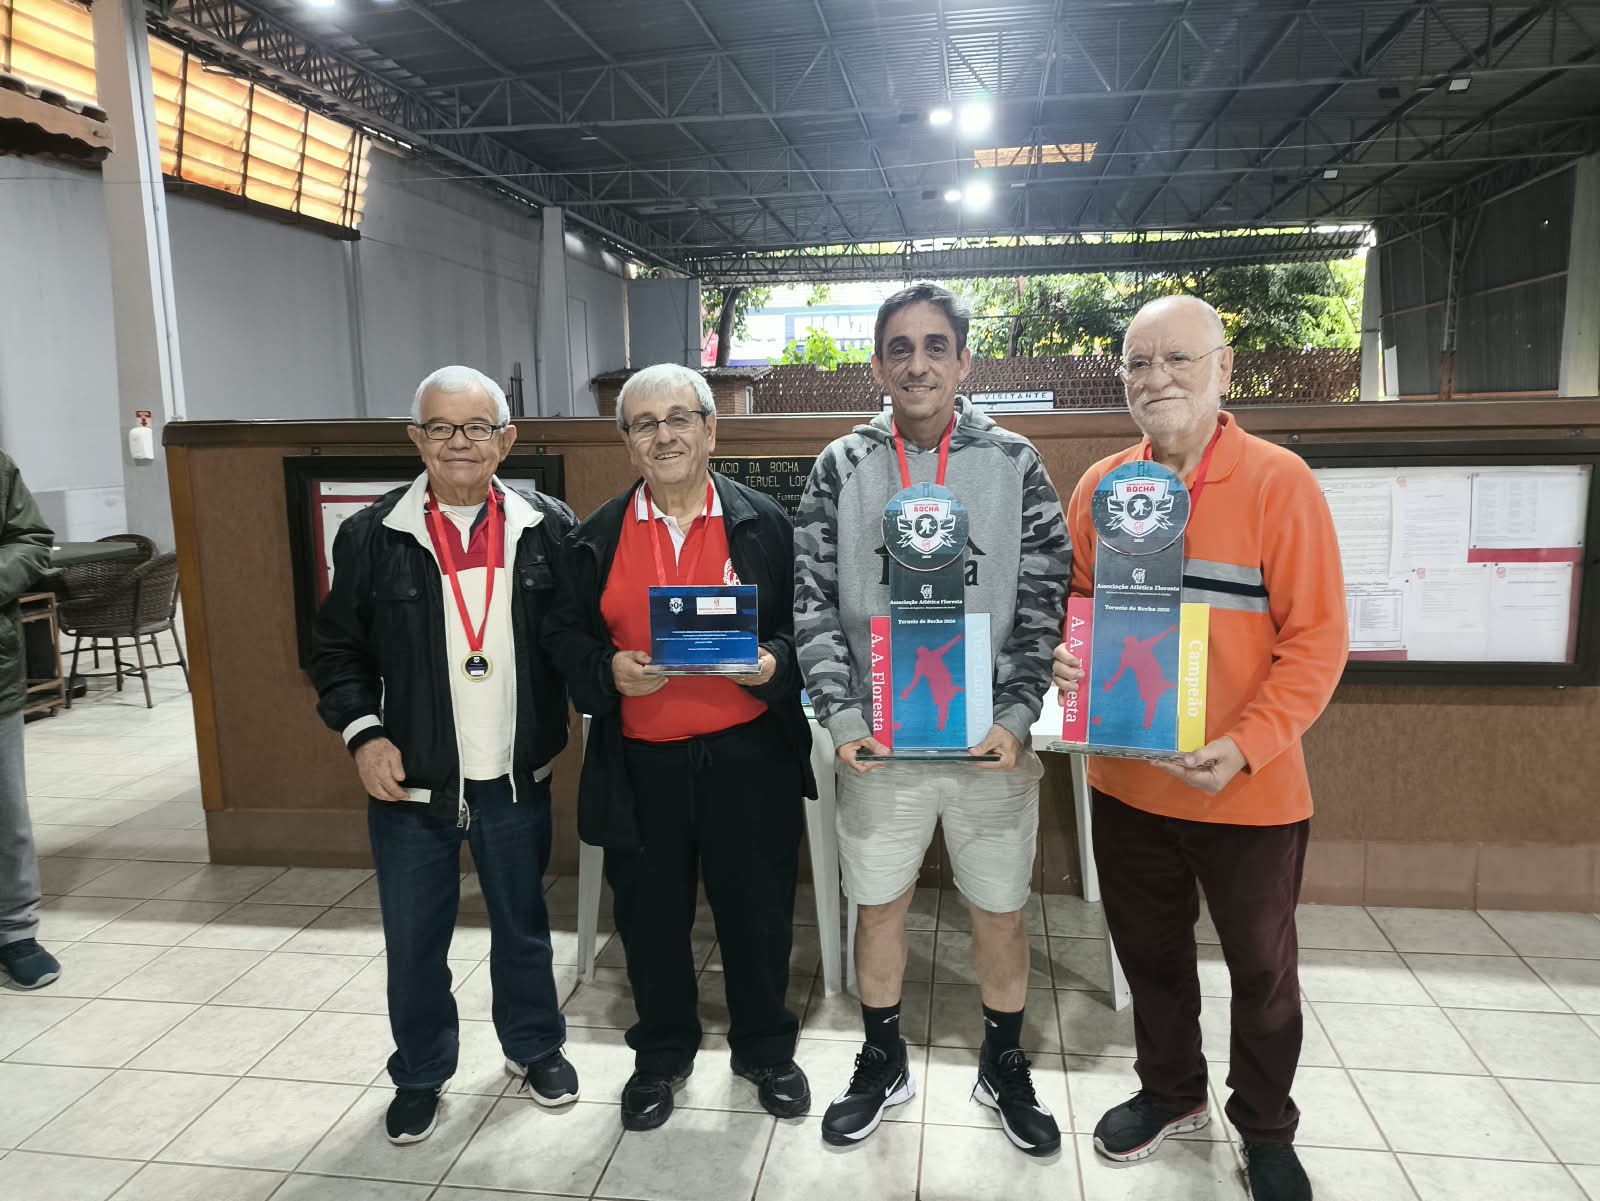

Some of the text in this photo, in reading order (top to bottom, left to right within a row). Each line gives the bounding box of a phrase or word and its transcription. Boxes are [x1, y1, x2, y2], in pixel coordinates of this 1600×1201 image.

[984, 392, 1047, 400] VISITANTE
[708, 460, 800, 474] ALÁCIO DA BOCHA
[745, 475, 781, 488] TERUEL
[789, 475, 807, 487] LOP
[1071, 615, 1086, 632] A.
[1069, 636, 1085, 653] A.
[871, 632, 886, 732] A. A. Floresta
[1183, 640, 1204, 719] Campeão
